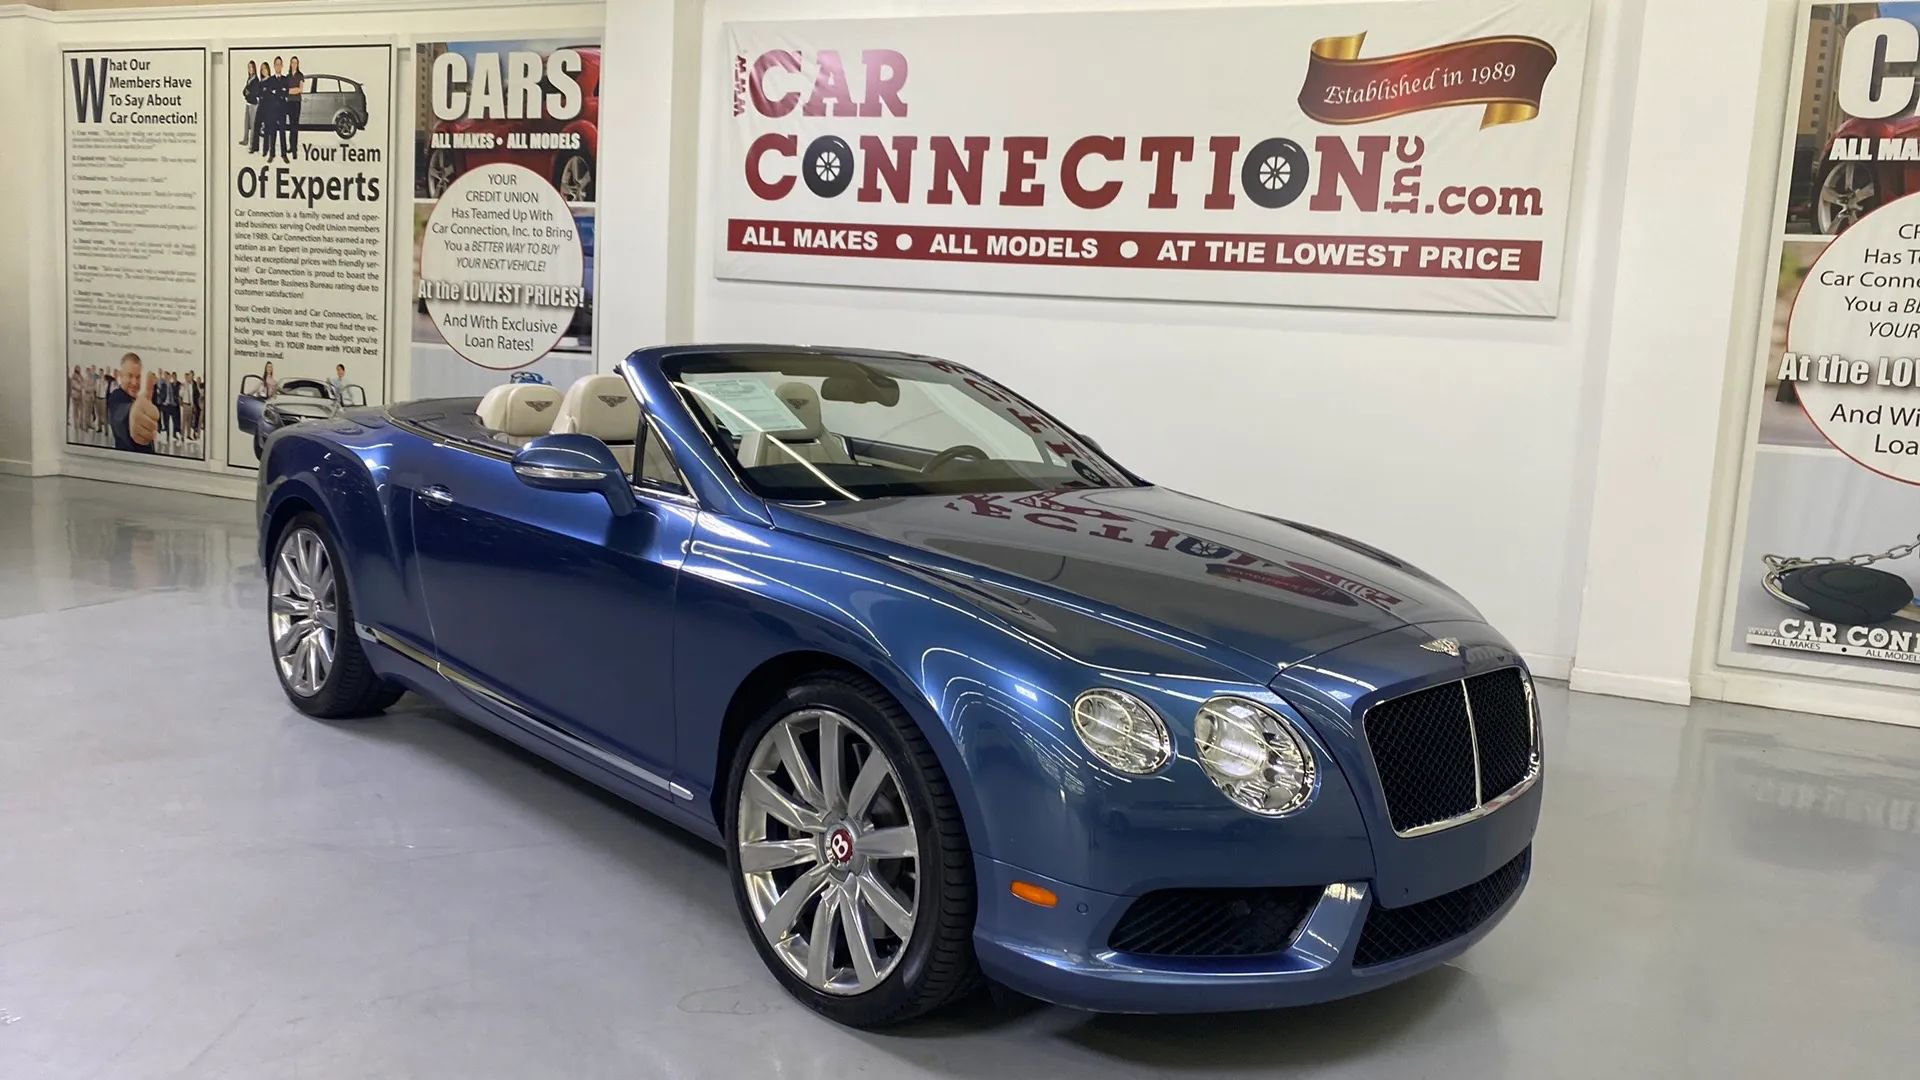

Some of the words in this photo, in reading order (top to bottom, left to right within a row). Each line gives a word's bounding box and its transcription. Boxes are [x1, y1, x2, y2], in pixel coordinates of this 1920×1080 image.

[130, 58, 151, 71] Our
[109, 76, 160, 88] Members
[163, 76, 192, 88] Have
[432, 49, 582, 120] CARS
[748, 49, 909, 118] CAR
[1323, 67, 1440, 104] Established
[1442, 68, 1463, 88] in
[1470, 62, 1516, 85] 1989
[109, 94, 122, 106] To
[125, 94, 144, 109] Say
[147, 94, 182, 106] About
[109, 112, 128, 124] Car
[130, 112, 198, 124] Connection!
[431, 133, 451, 148] ALL
[453, 133, 495, 149] MAKES
[506, 133, 528, 149] ALL
[530, 133, 581, 150] MODELS
[1828, 138, 1873, 161] ALL
[302, 143, 337, 162] Your
[340, 143, 381, 162] Team
[488, 174, 517, 185] YOUR
[744, 132, 1391, 213] CONNECTION
[237, 166, 269, 198] Of
[276, 167, 380, 208] Experts
[466, 190, 502, 202] CREDIT
[504, 191, 538, 203] UNION
[1425, 186, 1543, 216] .com
[247, 208, 284, 218] Connection
[451, 208, 469, 219] Has
[472, 208, 510, 220] Teamed
[513, 209, 528, 223] Up
[530, 209, 553, 221] With
[305, 222, 325, 231] Credit
[326, 224, 347, 232] Union
[432, 223, 449, 234] Car
[450, 224, 510, 237] Connection,
[512, 225, 530, 237] Inc.
[533, 226, 543, 238] to
[546, 227, 573, 241] Bring
[284, 233, 321, 242] Connection
[444, 240, 462, 251] You
[465, 243, 470, 251] a
[472, 240, 504, 253] BETTER
[505, 242, 527, 254] WAY
[527, 243, 541, 255] TO
[541, 244, 560, 255] BUY
[742, 226, 785, 247] ALL
[793, 228, 878, 252] MAKES
[929, 233, 978, 255] ALL
[987, 235, 1098, 260] MODELS
[1156, 240, 1196, 262] AT
[1205, 241, 1266, 264] THE
[1275, 242, 1408, 268] LOWEST
[1419, 246, 1521, 272] PRICE
[456, 257, 481, 270] YOUR
[482, 258, 506, 270] NEXT
[506, 259, 547, 272] VEHICLE!
[1864, 248, 1902, 265] Has
[268, 266, 305, 276] Connection
[1820, 270, 1855, 287] Car
[418, 279, 432, 299] At
[436, 280, 460, 300] the
[463, 281, 522, 304] LOWEST
[525, 284, 585, 308] PRICES!
[1844, 296, 1881, 312] You
[1887, 301, 1898, 313] a
[443, 313, 468, 328] And
[469, 314, 498, 330] With
[502, 316, 558, 334] Exclusive
[1869, 321, 1920, 339] YOUR
[465, 334, 494, 348] Loan
[498, 335, 534, 351] Rates!
[1777, 352, 1811, 382] At
[1817, 354, 1870, 385] the
[1830, 403, 1882, 425] And
[1890, 406, 1920, 428] Wi
[1874, 433, 1920, 456] Loa
[1779, 618, 1837, 644] CAR
[1771, 638, 1788, 648] ALL
[1789, 640, 1821, 651] MAKES
[1865, 649, 1882, 658] ALL
[1884, 651, 1920, 663] MODEL
